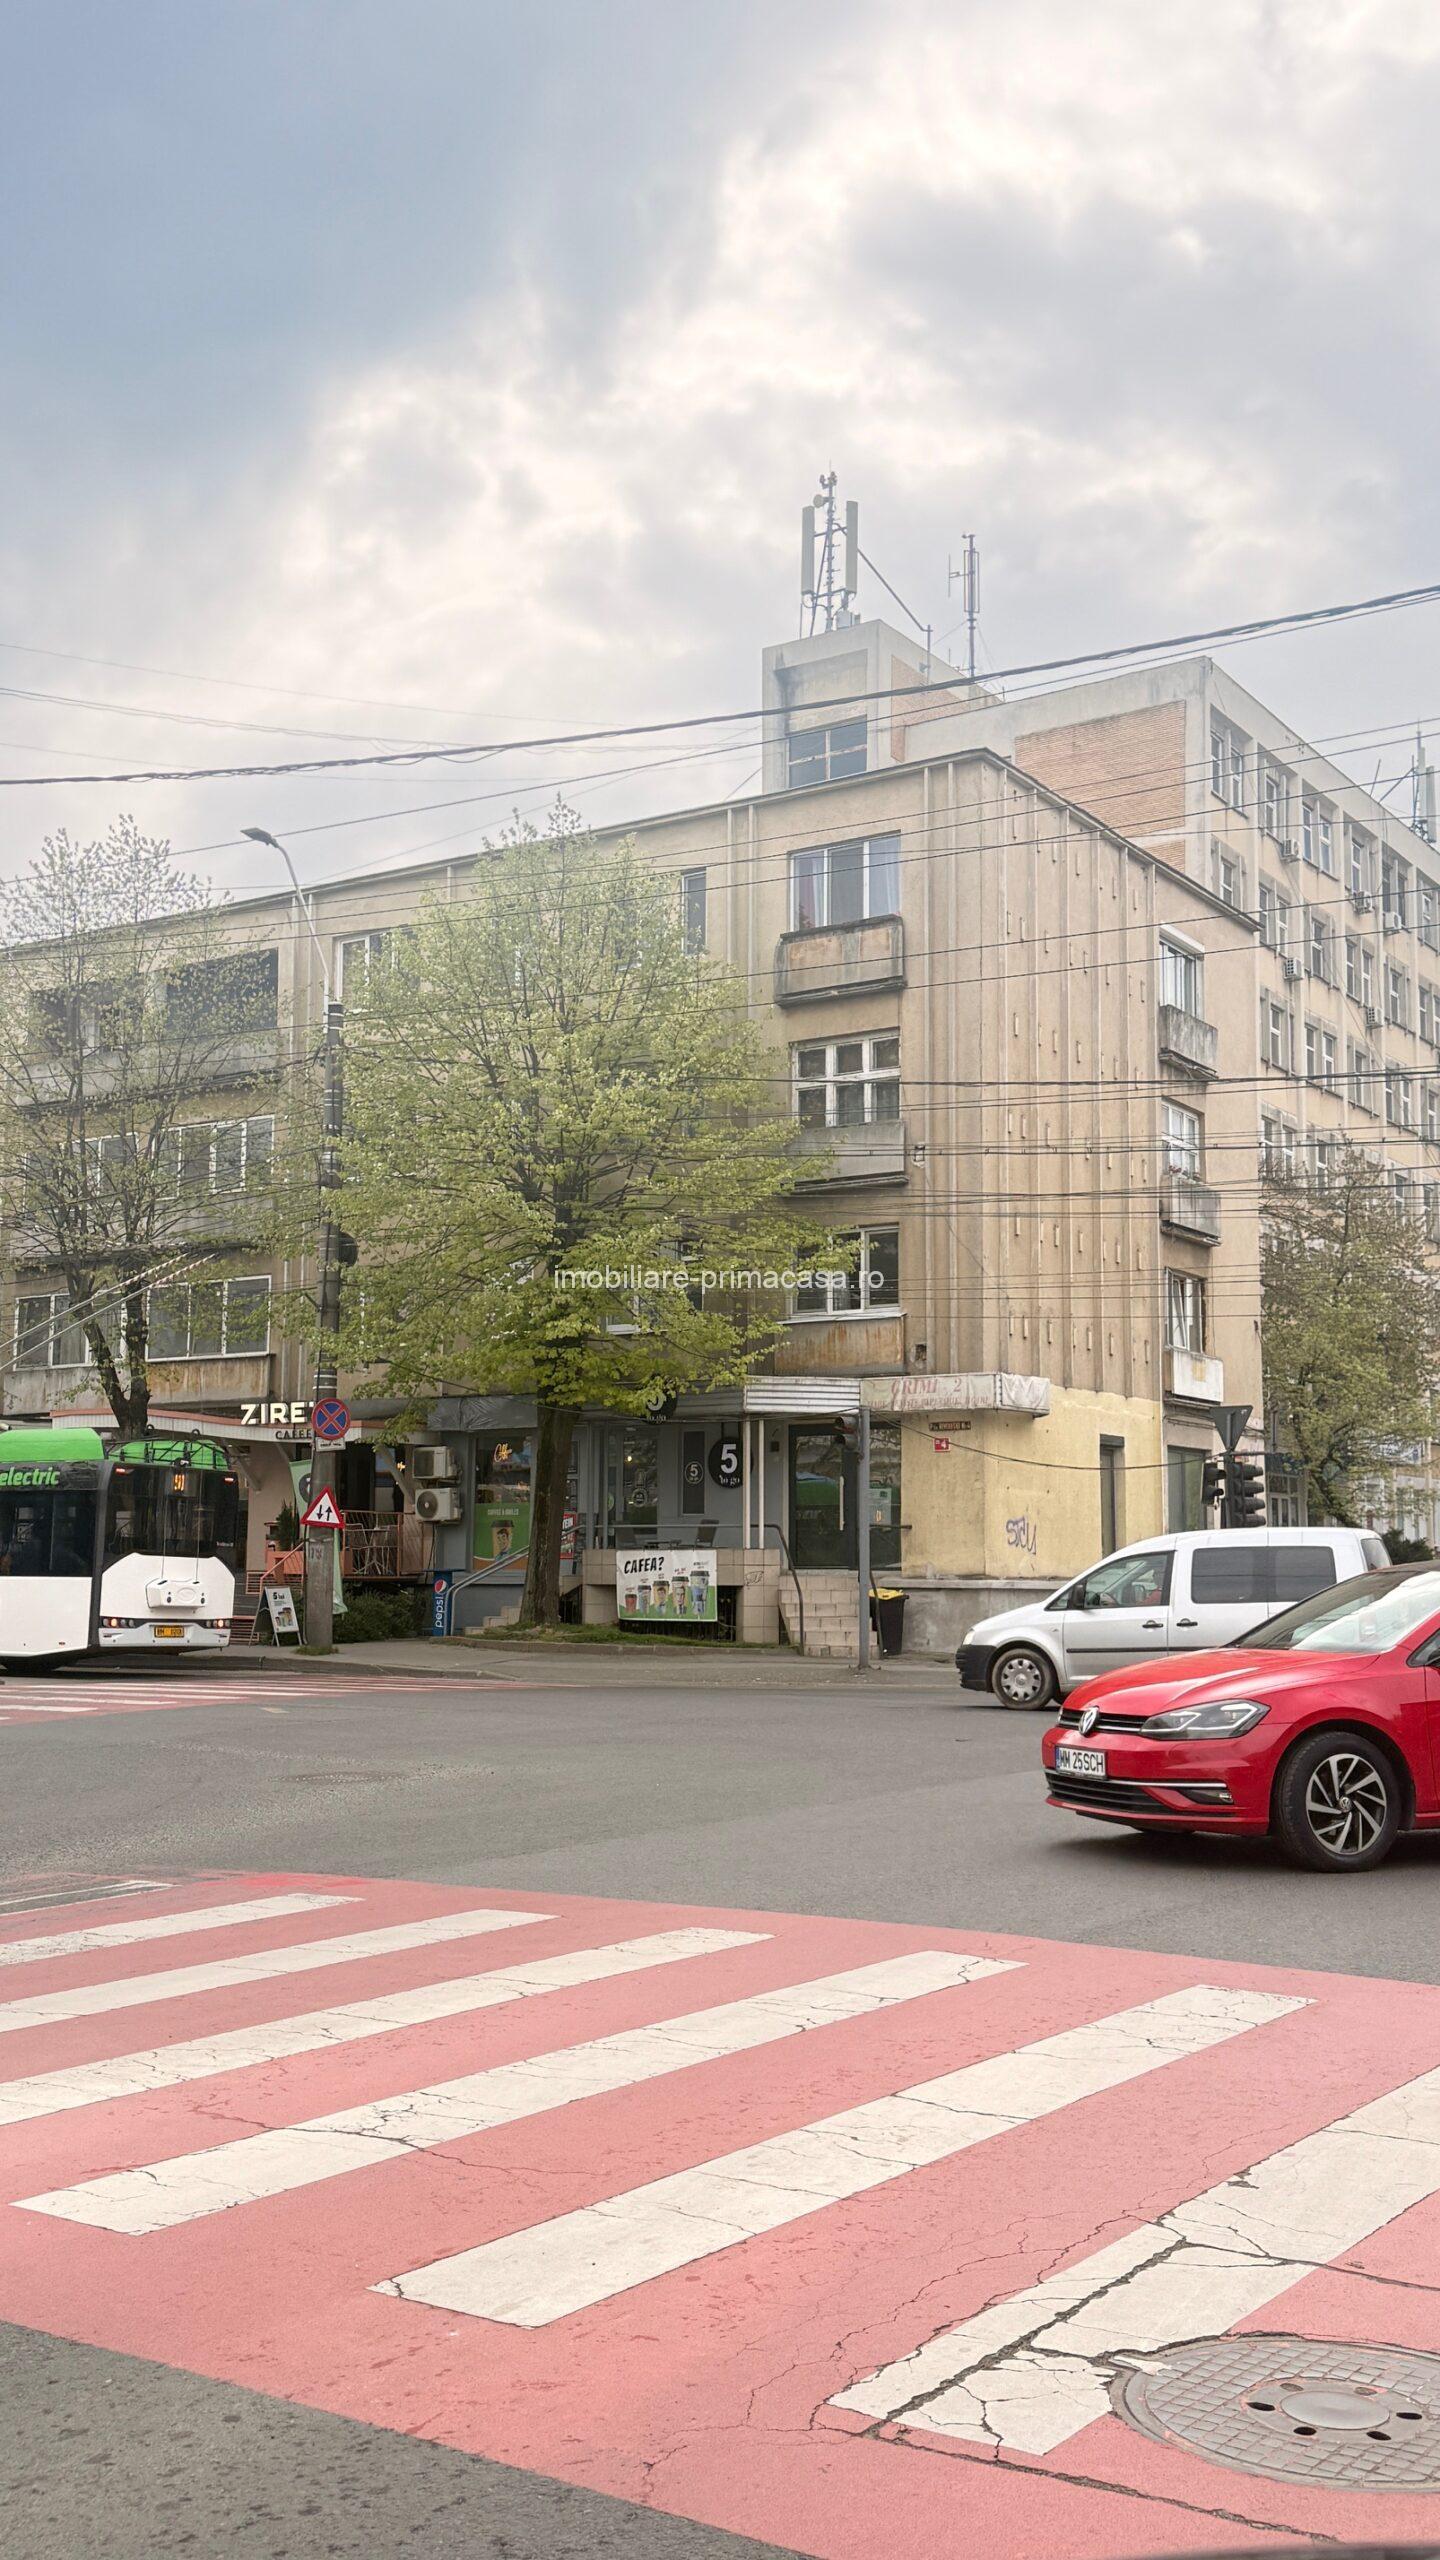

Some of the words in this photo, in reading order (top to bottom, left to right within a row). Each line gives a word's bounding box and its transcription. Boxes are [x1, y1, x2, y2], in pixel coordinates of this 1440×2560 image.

[721, 1443, 738, 1474] 5
[0, 1467, 61, 1486] electric
[689, 1463, 699, 1477] 5
[624, 1556, 665, 1574] CAFEA?
[435, 1596, 445, 1628] pepsi
